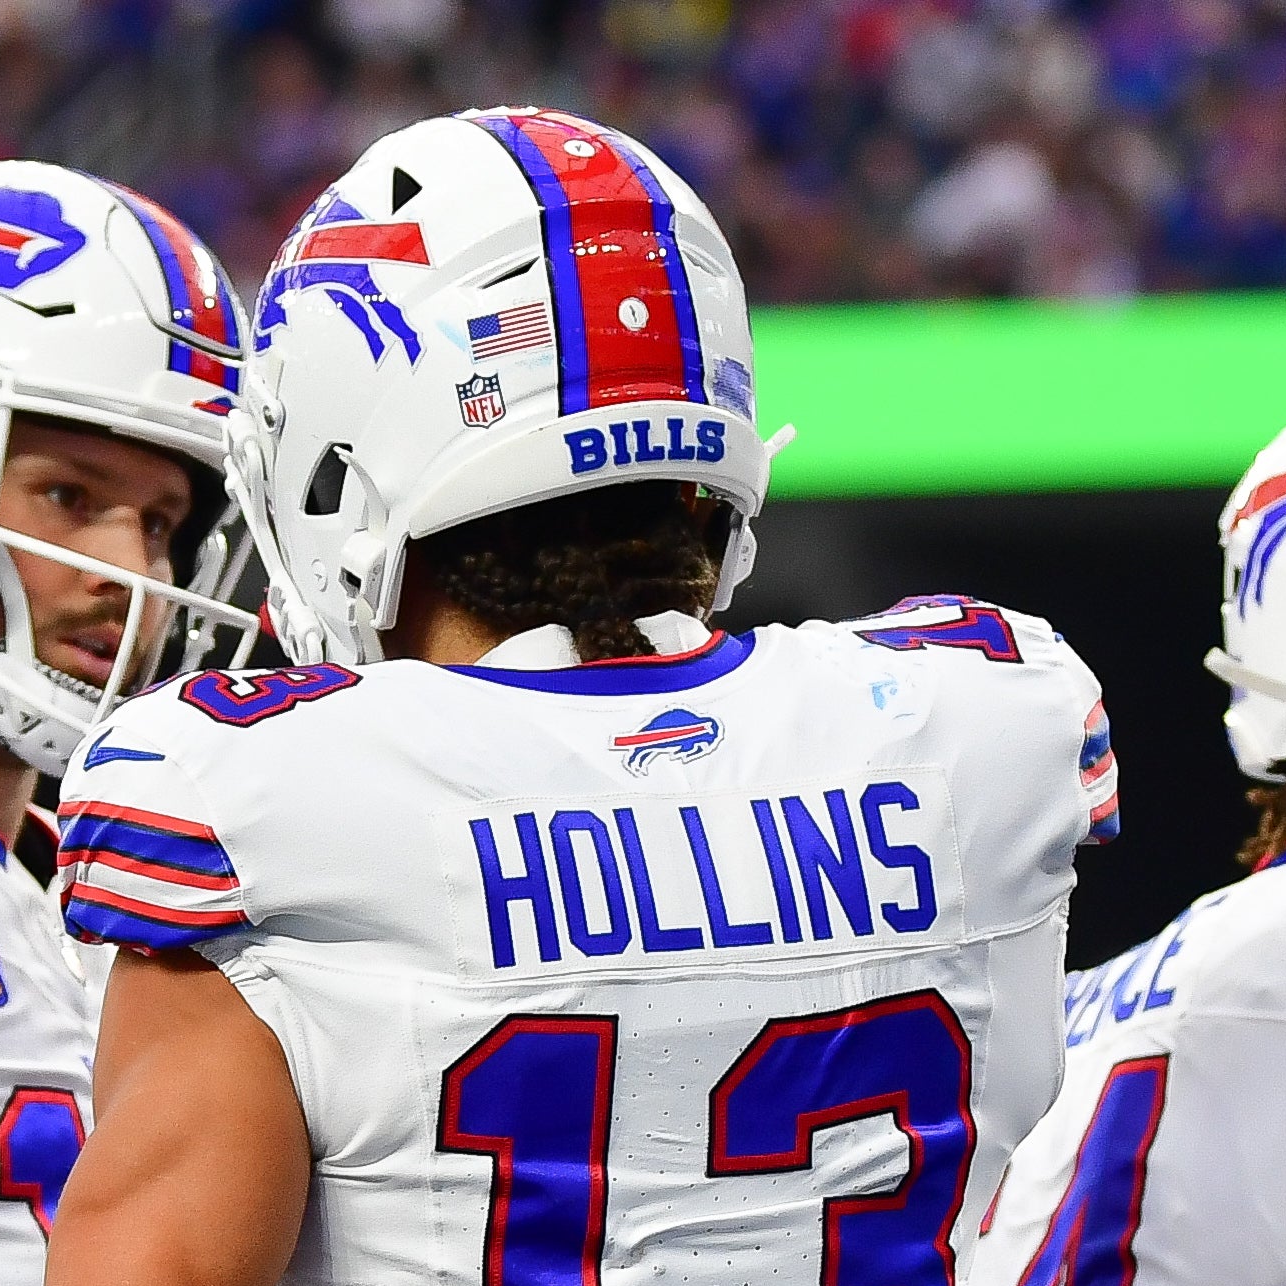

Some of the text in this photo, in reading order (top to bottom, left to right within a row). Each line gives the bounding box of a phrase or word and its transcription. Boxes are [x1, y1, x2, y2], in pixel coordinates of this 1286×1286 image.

[464, 396, 503, 423] NFL
[562, 418, 726, 474] BILLS
[852, 592, 1025, 665] 1
[124, 662, 364, 729] 3
[468, 781, 939, 969] HOLLINS
